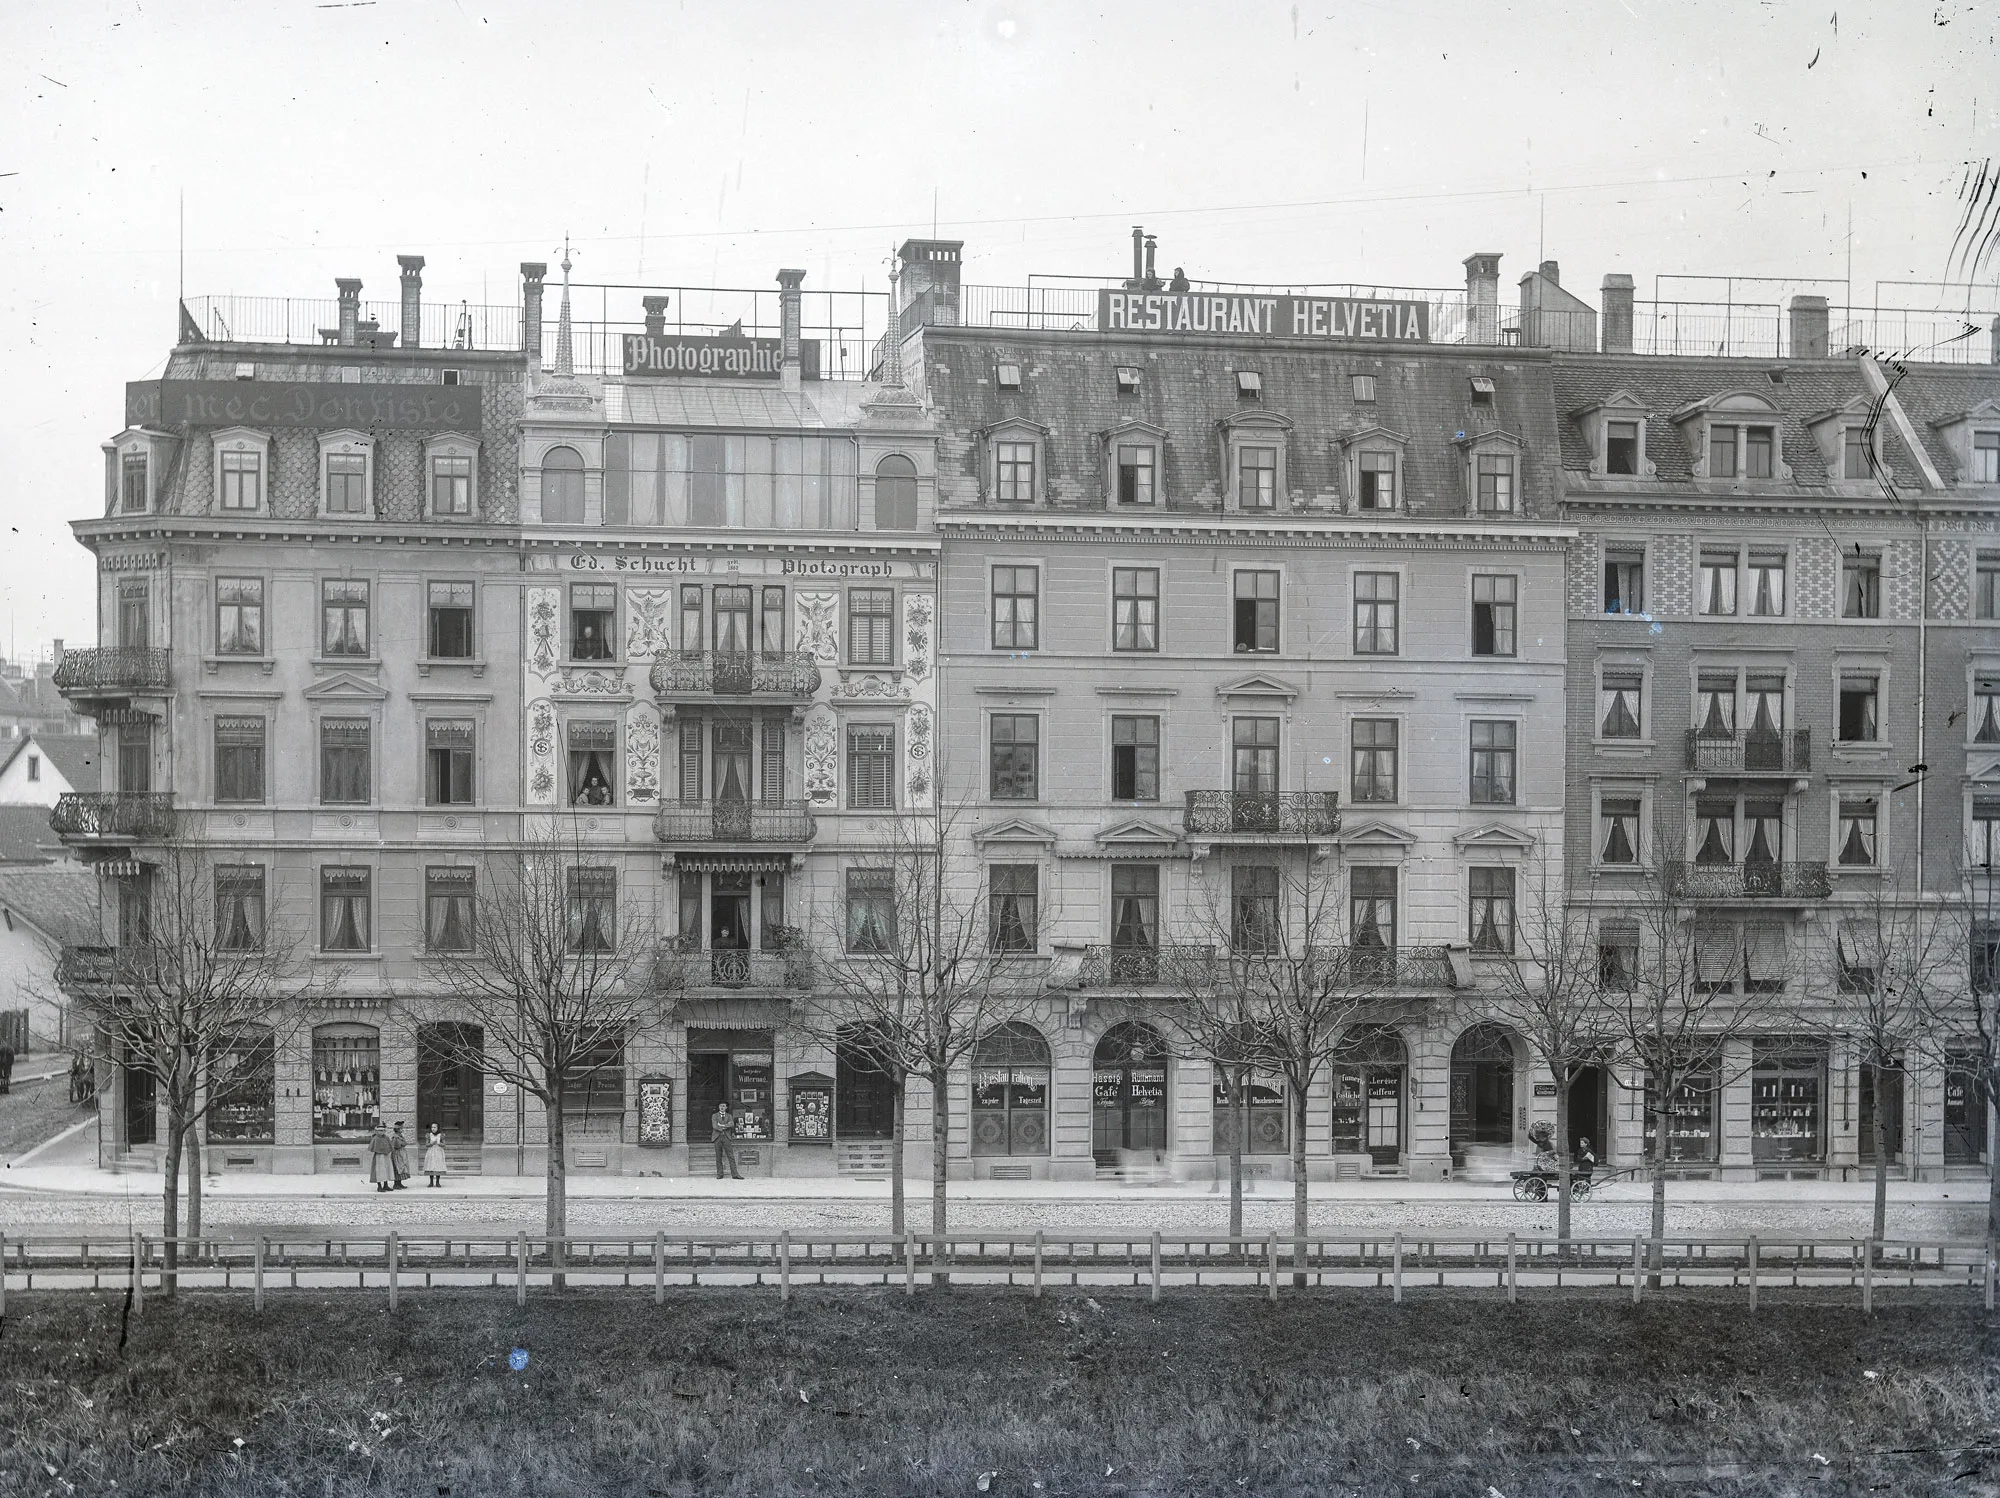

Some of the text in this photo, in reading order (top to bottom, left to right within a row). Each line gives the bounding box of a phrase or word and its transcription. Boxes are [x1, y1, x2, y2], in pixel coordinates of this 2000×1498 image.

[1108, 292, 1421, 339] RESTAURANT HELVETIA
[625, 334, 784, 376] Photographie
[570, 554, 698, 573] Ed. Schucht
[780, 558, 894, 578] Photograph
[1094, 1084, 1164, 1097] Café Helvetia
